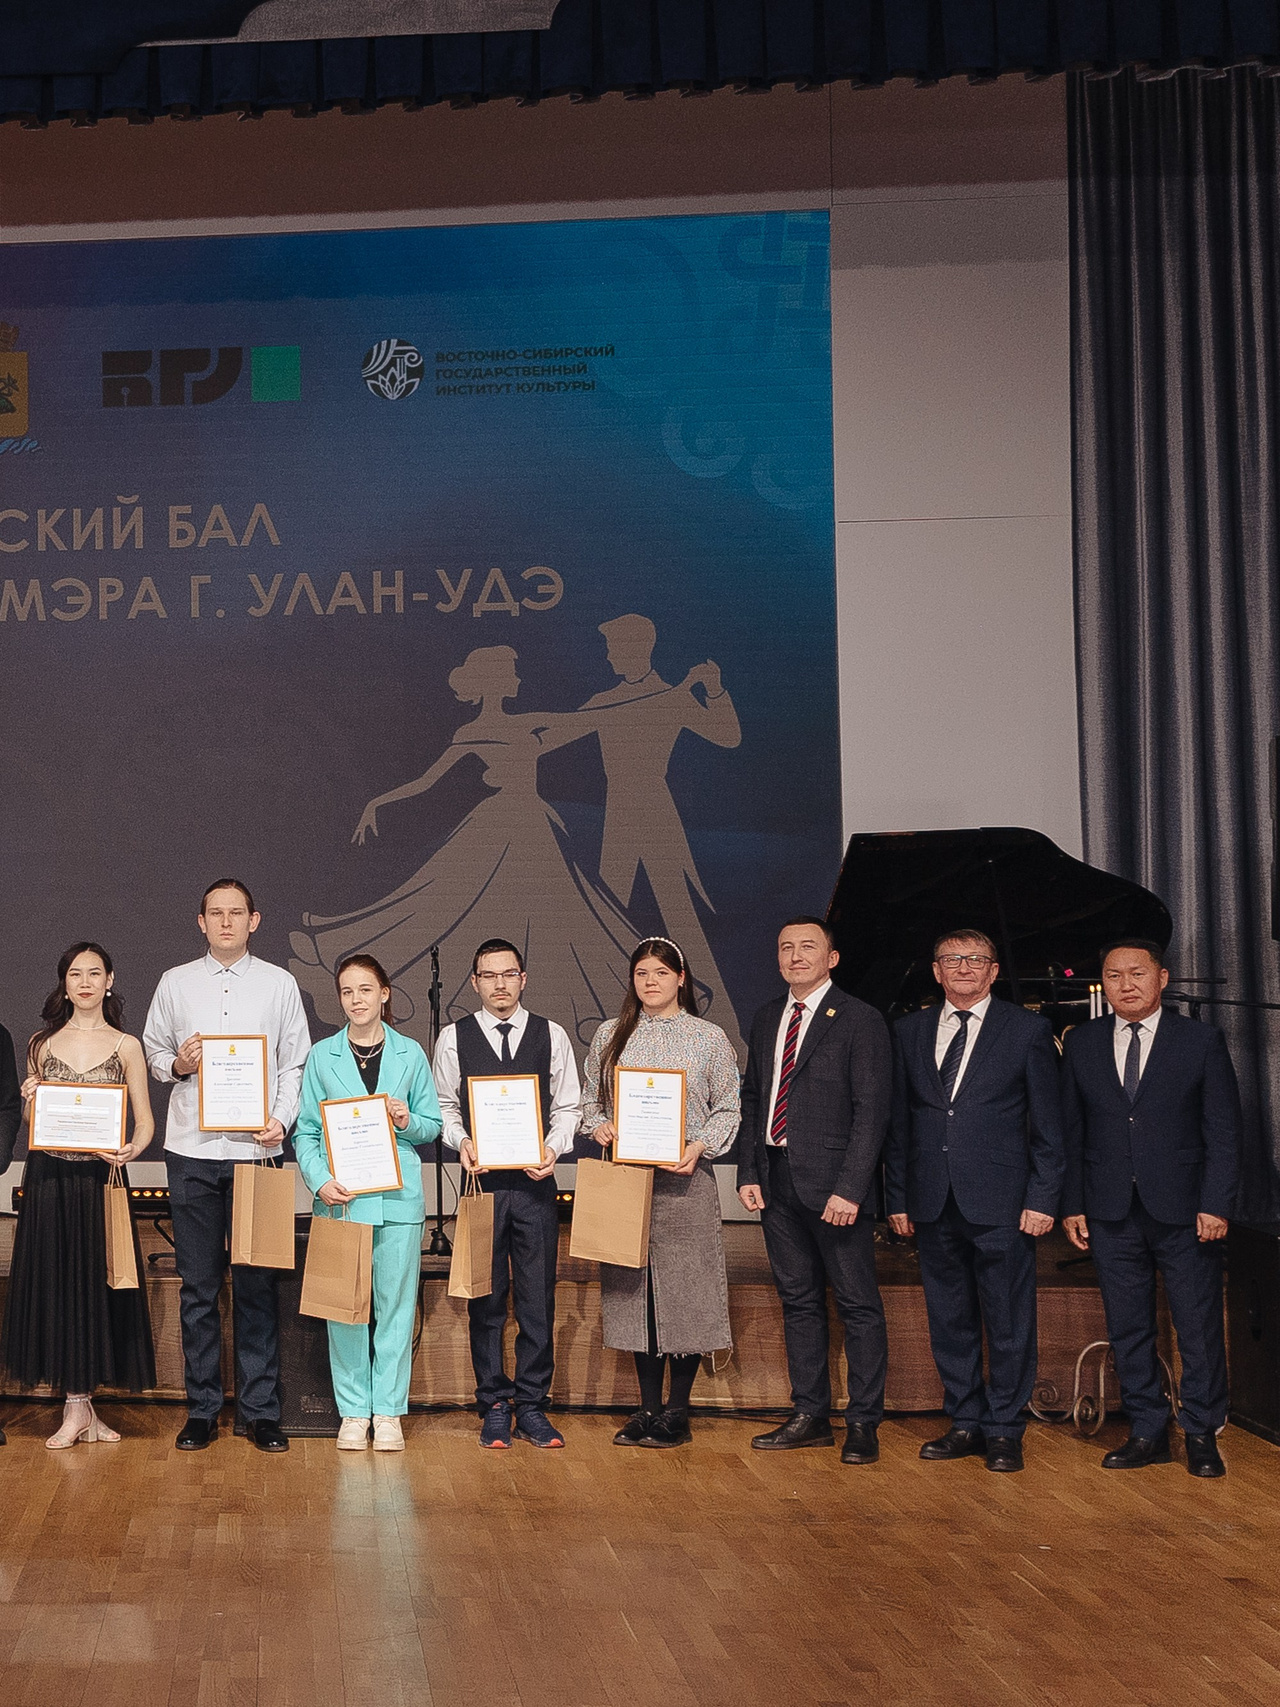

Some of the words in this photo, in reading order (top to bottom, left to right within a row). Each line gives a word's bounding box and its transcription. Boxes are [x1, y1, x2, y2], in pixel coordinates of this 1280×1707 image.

[435, 344, 616, 363] ВОСТОЧНО-СИБИРСКИЙ
[435, 361, 588, 379] ГОСУДАРСТВЕННЫЙ
[435, 382, 512, 396] ИНСТИТУТ
[515, 380, 596, 393] КУЛЬТУРЫ
[169, 503, 282, 549] БАЛ
[190, 575, 226, 618] Г.
[247, 566, 567, 617] УЛАН-УДЭ
